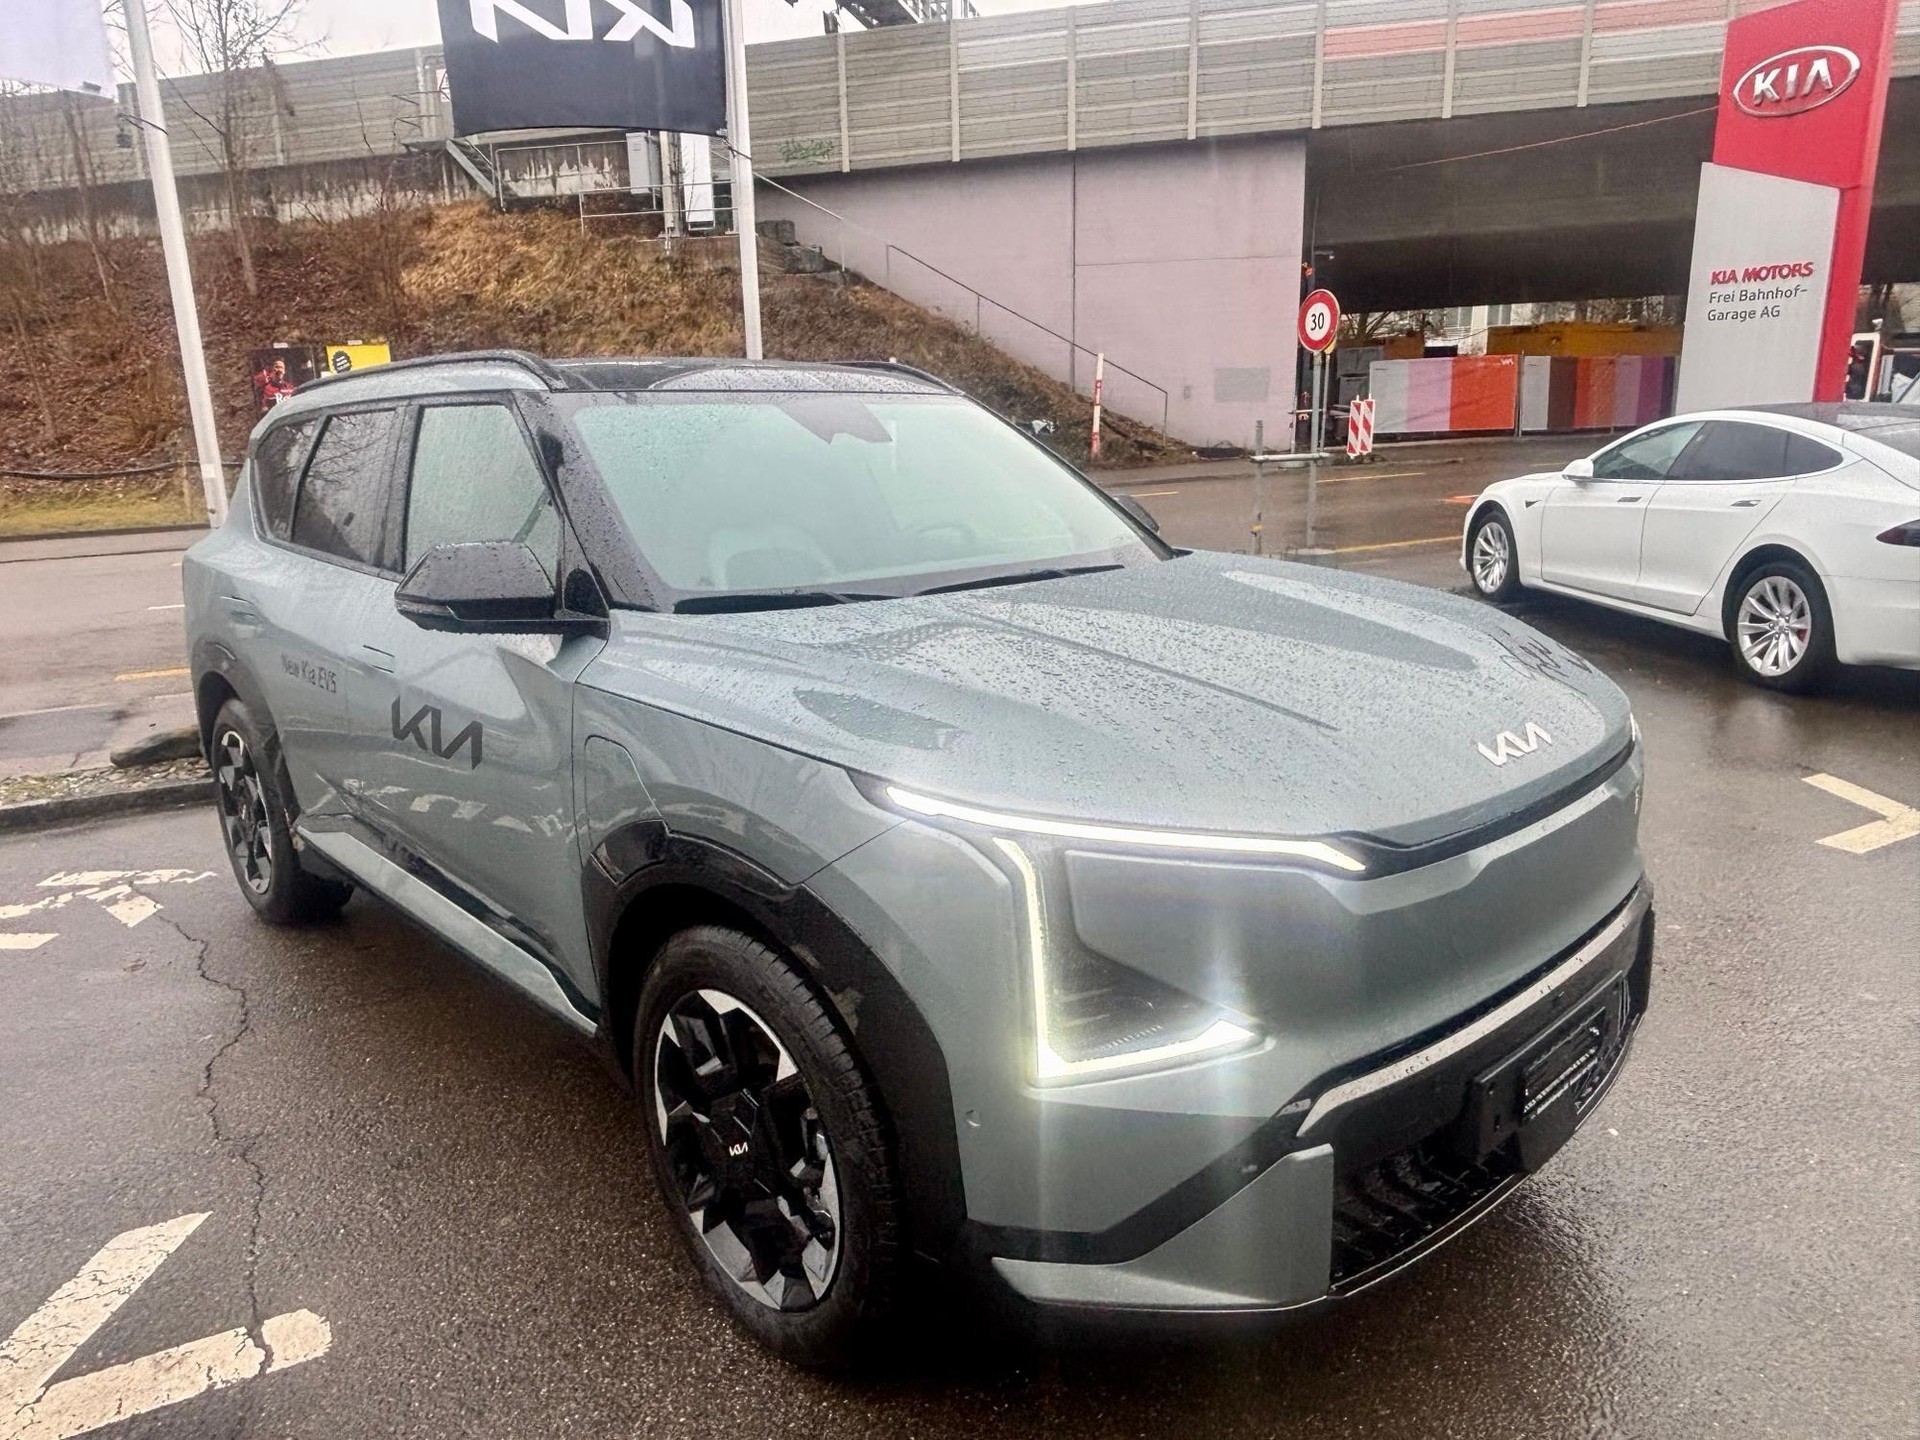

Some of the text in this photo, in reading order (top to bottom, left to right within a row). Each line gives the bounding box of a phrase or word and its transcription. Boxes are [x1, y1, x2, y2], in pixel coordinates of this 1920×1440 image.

[1752, 56, 1834, 107] KIA
[1710, 261, 1815, 286] KIA MOTORS
[1708, 284, 1808, 304] Frei Bahnhof-
[1310, 311, 1325, 332] 30
[1706, 304, 1781, 323] Garage AG
[391, 694, 484, 771] KIA
[1476, 720, 1553, 768] KIA
